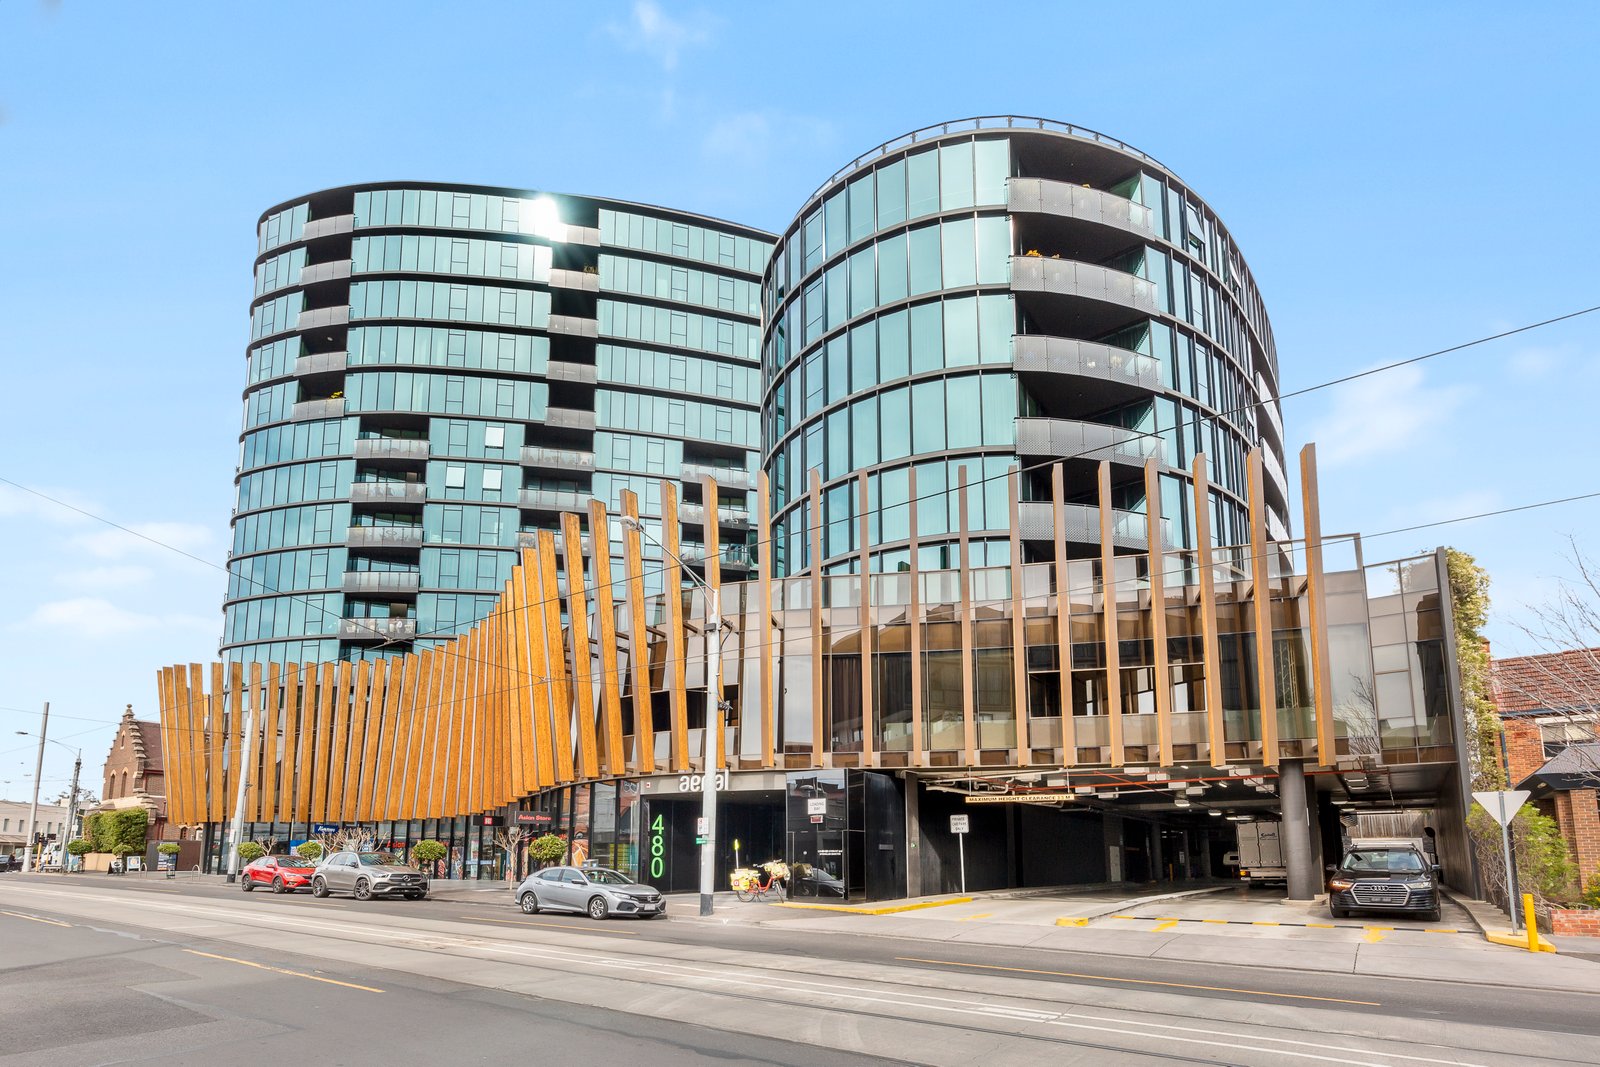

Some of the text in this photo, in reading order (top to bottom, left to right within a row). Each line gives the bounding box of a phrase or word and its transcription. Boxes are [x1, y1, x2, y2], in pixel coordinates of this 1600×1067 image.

[679, 768, 729, 792] aeal
[386, 839, 406, 849] Asian
[650, 813, 665, 879] 480
